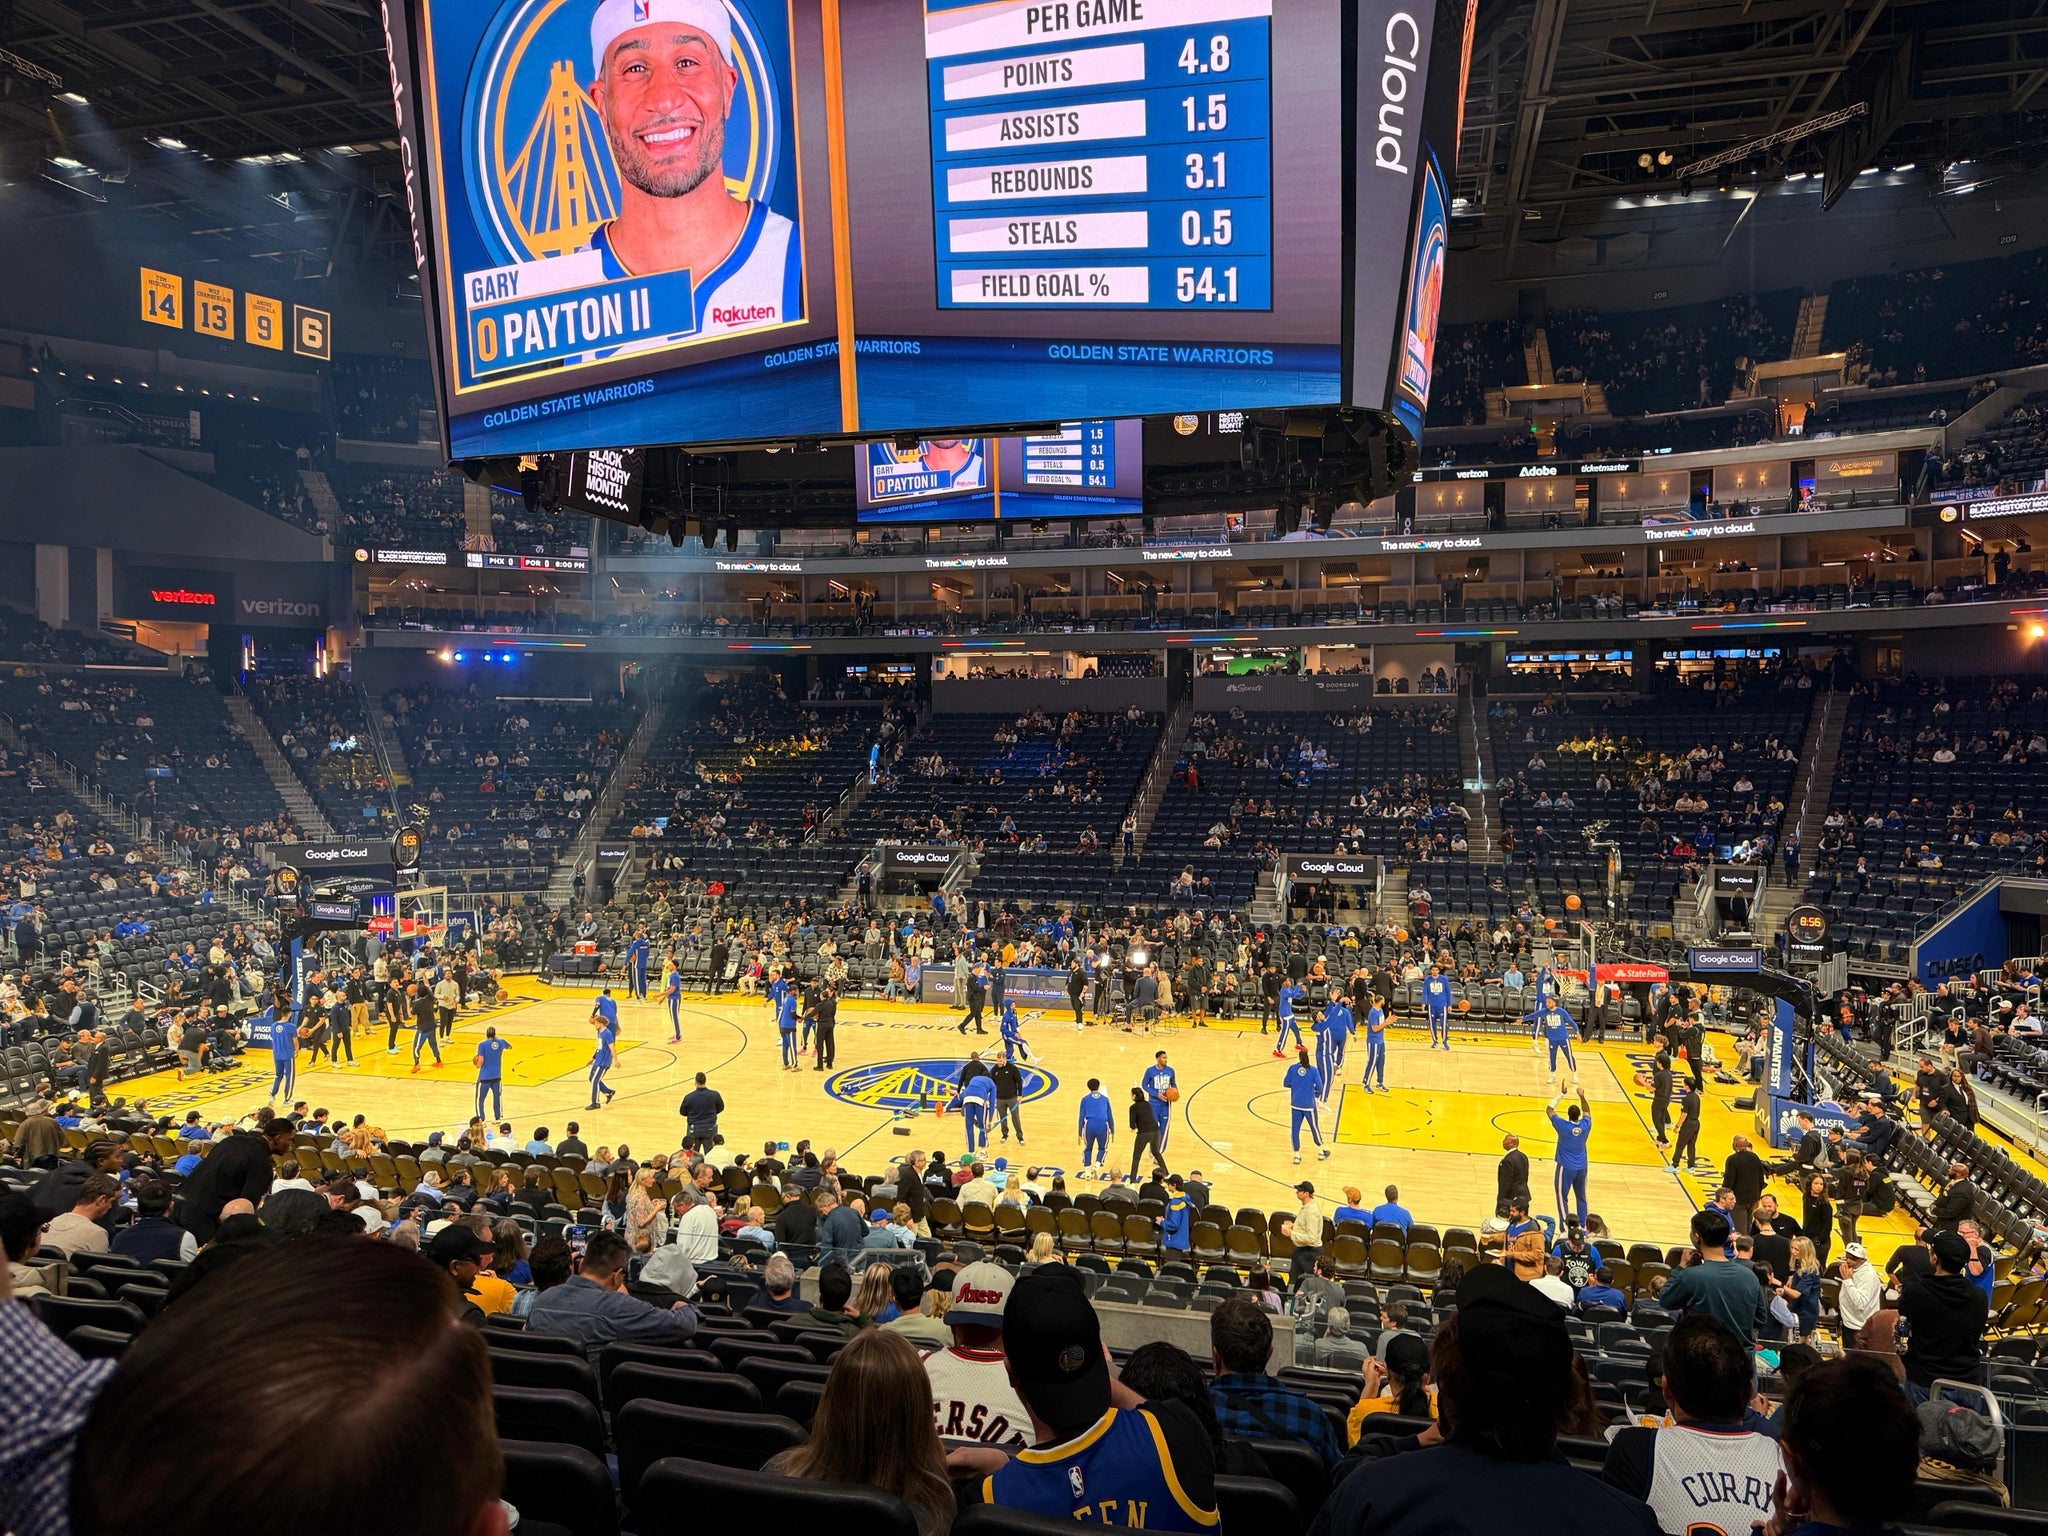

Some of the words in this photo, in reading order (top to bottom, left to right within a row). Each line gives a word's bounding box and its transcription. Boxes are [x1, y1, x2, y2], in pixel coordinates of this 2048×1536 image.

[1026, 5, 1070, 34] PER
[1074, 0, 1144, 28] GAME
[1178, 35, 1230, 74] 4.8
[1004, 59, 1073, 88] POINTS
[1375, 13, 1419, 173] Cloud
[1182, 93, 1228, 132] 1.5
[1000, 113, 1080, 142] ASSISTS
[991, 165, 1093, 194] REBOUNDS
[1186, 152, 1227, 190] 3.1
[401, 135, 425, 269] Cloud
[1008, 220, 1078, 246] STEALS
[1181, 210, 1233, 246] 0.5
[472, 270, 519, 303] GARY
[982, 274, 1032, 298] FIELD
[1036, 274, 1086, 298] GOAL
[1089, 273, 1110, 298] %
[1176, 266, 1239, 304] 54.1
[149, 290, 176, 320] 14
[712, 303, 776, 326] Rakuten
[202, 302, 226, 332] 13
[477, 317, 498, 362] 0
[504, 295, 623, 358] PAYTON
[628, 287, 650, 332] II
[258, 316, 272, 341] 9
[302, 317, 322, 349] 6
[764, 344, 812, 368] GOLDEN
[814, 341, 842, 360] STAT
[853, 340, 920, 356] WARRIORS
[1048, 345, 1112, 360] GOLDEN
[1118, 346, 1168, 362] STATE
[1172, 347, 1274, 365] WARRIORS
[484, 403, 538, 428] GOLDEN
[541, 396, 581, 419] STATE
[583, 380, 654, 404] WARRIORS
[1090, 429, 1103, 440] 1.5
[589, 450, 622, 468] BLACK
[1091, 444, 1103, 455] 3.1
[588, 459, 630, 486] HISTORY
[876, 466, 894, 475] GARY
[1090, 460, 1104, 470] 0.5
[1519, 466, 1557, 478] Adobe
[1580, 464, 1630, 473] ticketmaster
[888, 476, 928, 492] PAYTON
[930, 474, 938, 487] II
[1088, 475, 1106, 486] 54.1
[1457, 470, 1488, 480] verizon
[586, 474, 622, 498] MONTH
[1970, 505, 1996, 515] BLACK
[1997, 502, 2032, 512] HISTORY
[1645, 530, 1663, 540] The
[1692, 528, 1712, 537] way
[1713, 526, 1724, 534] to
[1725, 522, 1756, 534] cloud.
[1381, 541, 1398, 550] The
[1399, 540, 1417, 550] new
[1424, 540, 1442, 550] way
[1444, 538, 1454, 548] to
[1454, 537, 1482, 548] cloud.
[926, 559, 939, 568] The
[960, 560, 976, 568] way
[978, 558, 986, 566] to
[988, 556, 1008, 566] cloud.
[1142, 552, 1158, 560] The
[1182, 551, 1198, 560] way
[1198, 550, 1208, 558] to
[1208, 548, 1232, 557] cloud.
[716, 562, 730, 571] The
[753, 564, 768, 572] way
[770, 563, 778, 571] to
[778, 562, 802, 572] cloud.
[152, 588, 216, 605] verizon
[242, 598, 320, 617] verizon
[1238, 684, 1264, 694] Sports
[305, 849, 340, 862] Google
[341, 848, 368, 858] Cloud
[896, 852, 924, 864] Google
[926, 852, 950, 862] Cloud
[1301, 861, 1335, 874] Google
[1336, 862, 1364, 873] Cloud
[346, 884, 374, 892] Rakuten
[316, 906, 335, 914] Google
[335, 906, 350, 914] Cloud
[1800, 917, 1821, 928] 8:56
[1700, 954, 1728, 965] Google
[1730, 954, 1753, 964] Cloud
[1926, 957, 1972, 978] CHASE
[936, 983, 954, 992] Goog
[1770, 1026, 1784, 1090] ADVANTEST
[1566, 1260, 1590, 1270] TOWN
[956, 1283, 1003, 1304] Sixers
